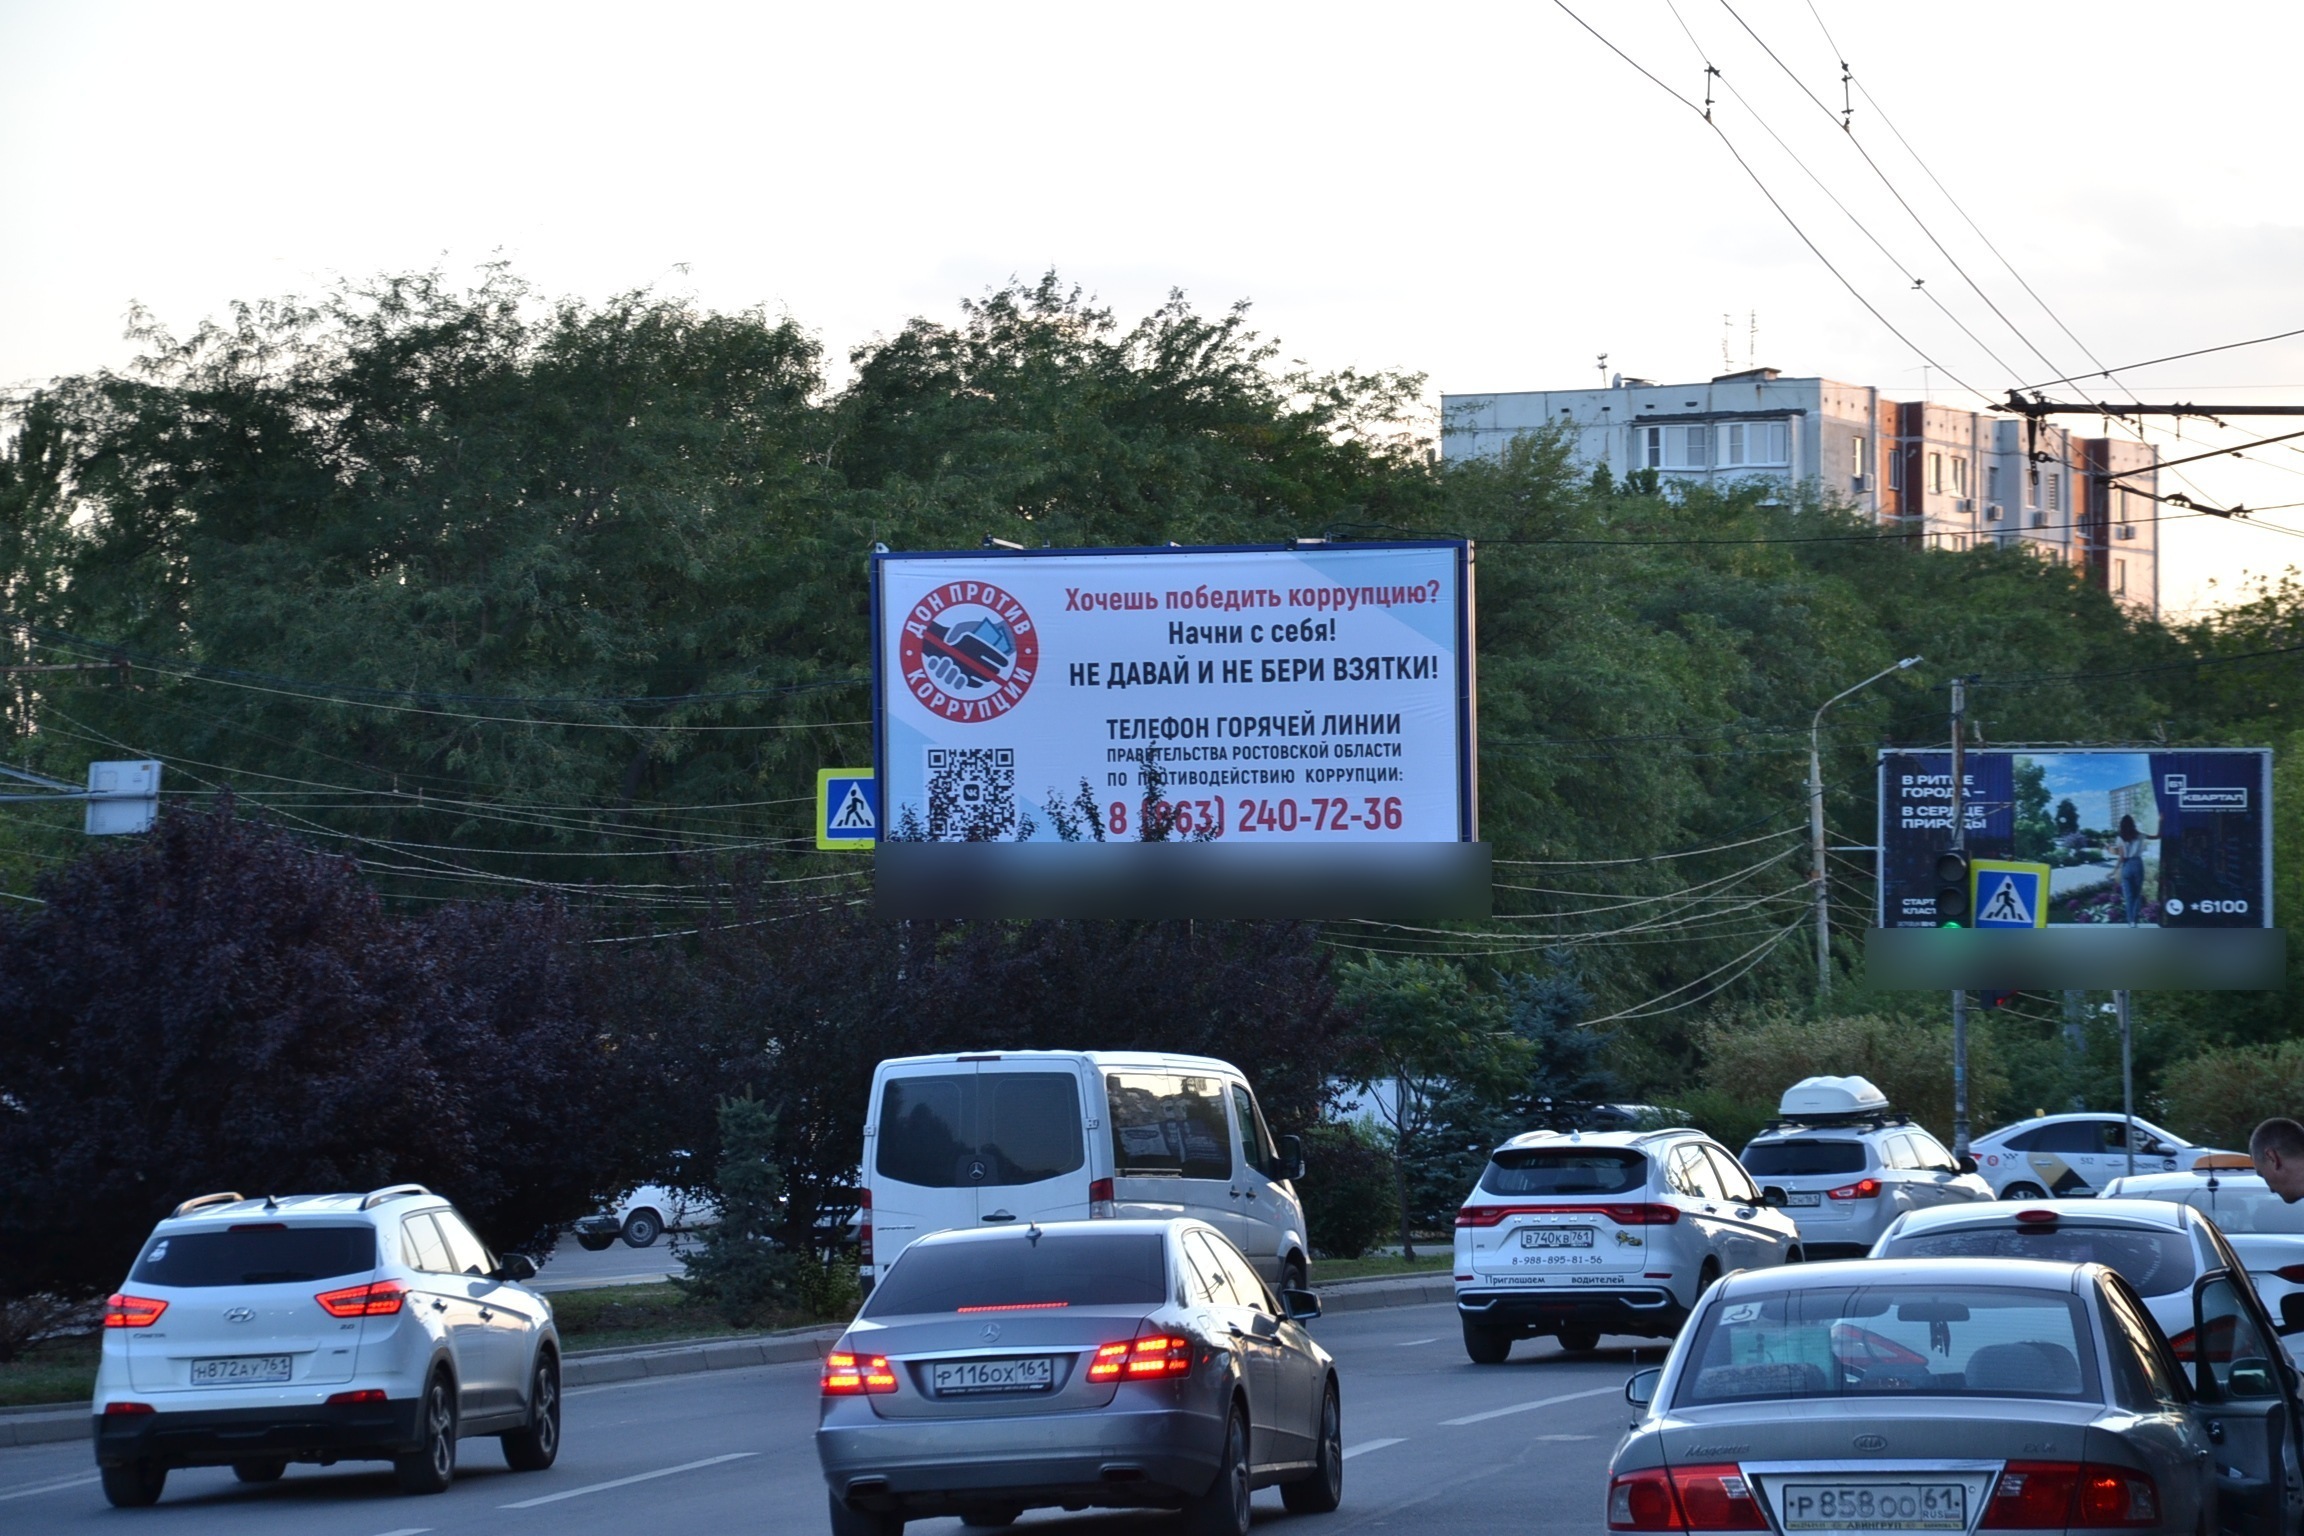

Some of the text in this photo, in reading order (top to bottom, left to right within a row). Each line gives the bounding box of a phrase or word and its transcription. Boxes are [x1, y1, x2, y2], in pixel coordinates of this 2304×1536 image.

[1065, 579, 1440, 611] Хочешь победить коррупцию?
[906, 583, 1031, 639] ДОН ПРОТИВ
[1169, 617, 1336, 644] Начни с себя!
[1070, 654, 1438, 689] НЕ ДАВАЙ И НЕ БЕРИ ВЗЯТКИ!
[907, 667, 1032, 720] КОРРУПЦИИ
[1106, 709, 1401, 740] ТЕЛЕФОН ГОРЯЧЕЙ ЛИНИИ
[1233, 741, 1329, 760] РОСТОВСКОЙ
[1334, 743, 1402, 758] ОБЛАСТИ
[1107, 772, 1127, 786] ПО
[1305, 767, 1403, 784] КОРРУПЦИИ:
[1902, 775, 1974, 785] В РИТЕ
[1109, 801, 1127, 835] 8
[1238, 796, 1403, 832] 240-72-36
[1902, 806, 1914, 816] В
[1512, 1256, 1602, 1265] 8-988-895-81-56
[1485, 1275, 1624, 1286] Приглашаем водителей
[1018, 1361, 1046, 1376] 161
[1924, 1488, 1952, 1510] 61
